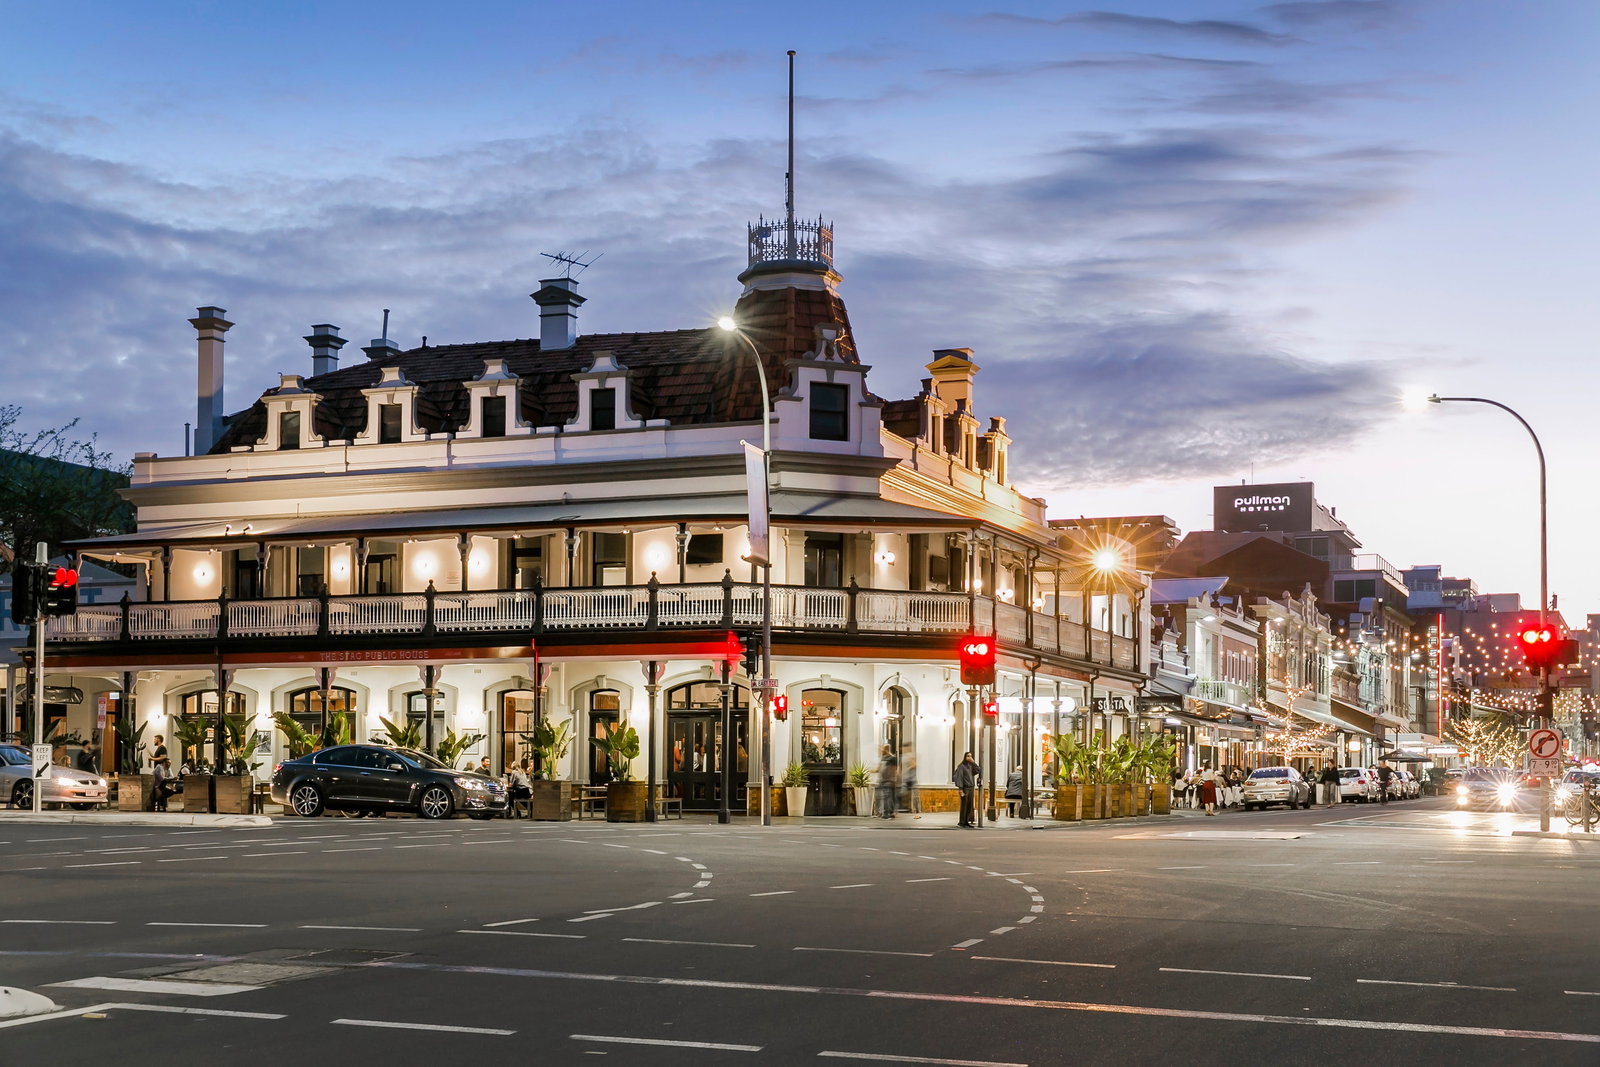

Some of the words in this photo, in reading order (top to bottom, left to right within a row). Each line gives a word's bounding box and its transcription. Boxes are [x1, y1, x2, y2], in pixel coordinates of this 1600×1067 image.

[1234, 495, 1291, 508] pullman
[1240, 505, 1285, 513] HOTELS
[320, 652, 336, 661] THE
[340, 651, 362, 661] STAG
[365, 650, 397, 660] PUBLIC
[399, 650, 429, 659] HOUSE
[1532, 760, 1537, 769] 7
